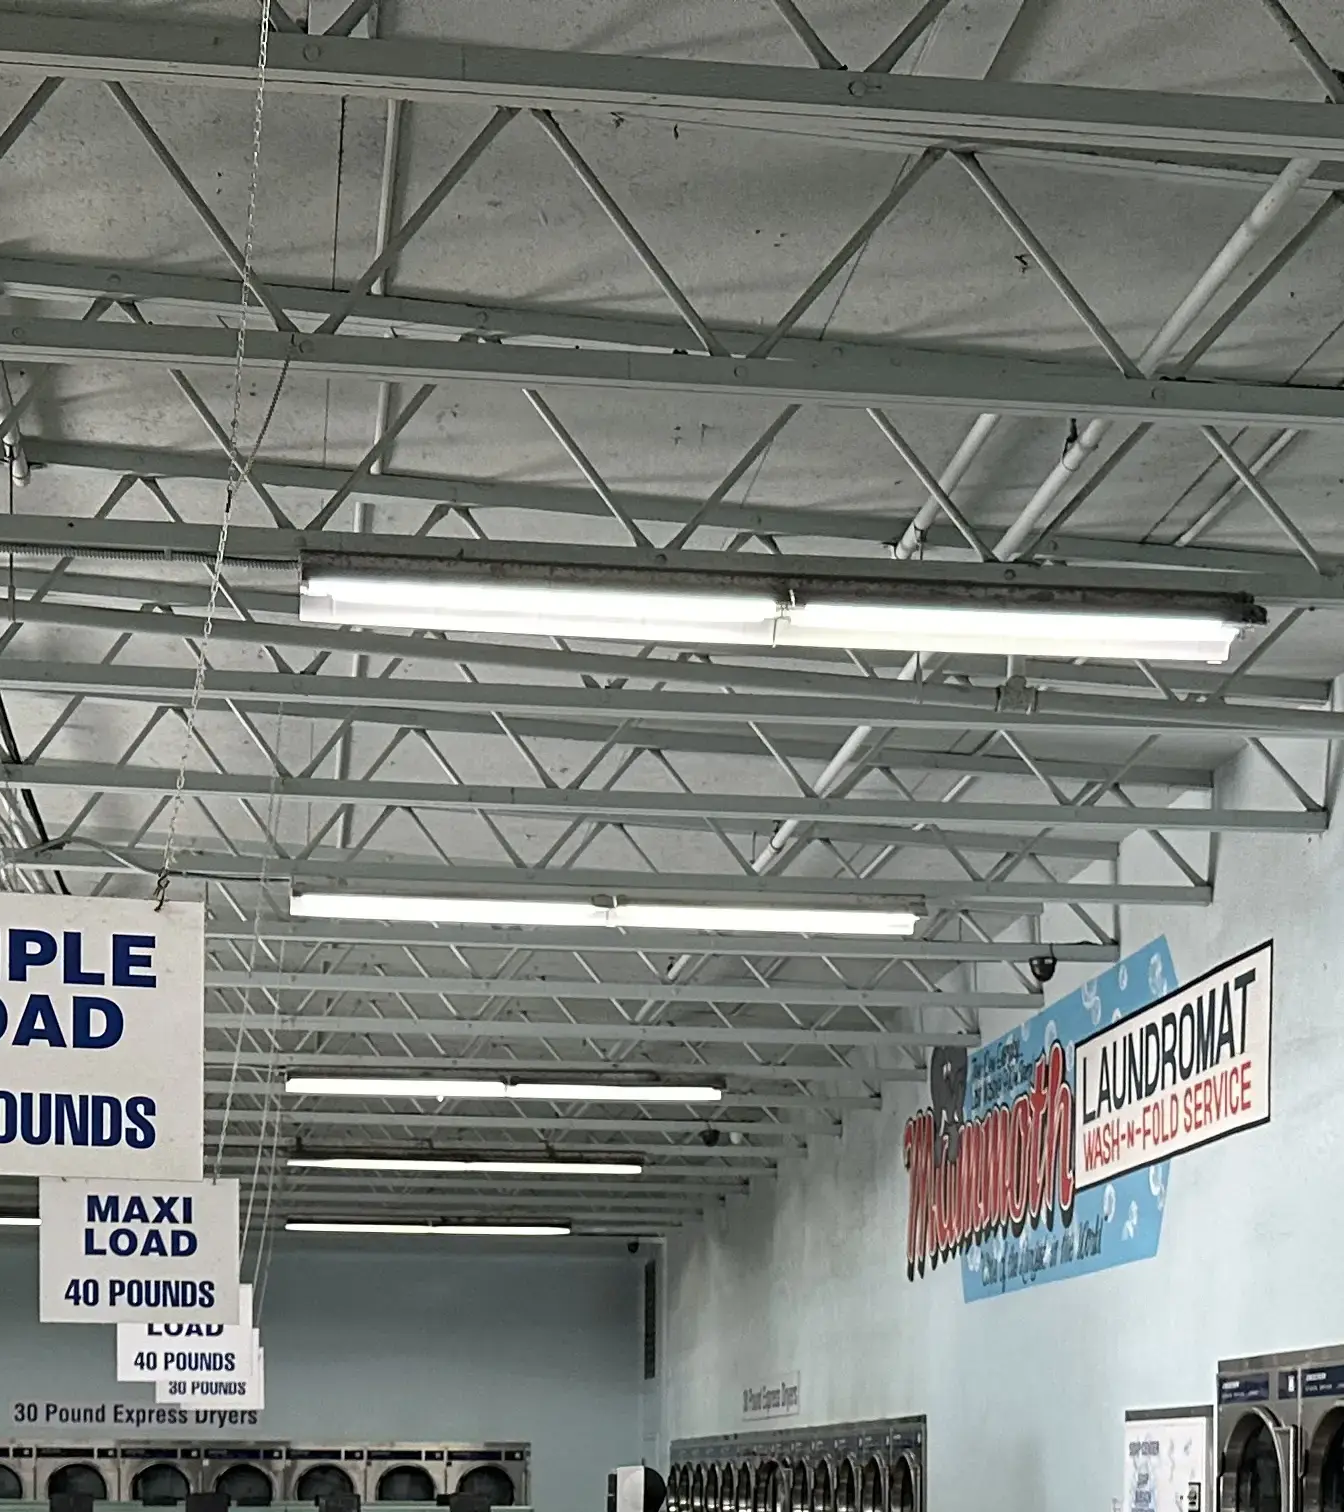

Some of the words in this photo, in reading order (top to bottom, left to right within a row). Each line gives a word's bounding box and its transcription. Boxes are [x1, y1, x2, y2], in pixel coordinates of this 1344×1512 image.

[1082, 967, 1257, 1126] LAUNDROMAT
[1083, 1092, 1180, 1173] WASH-N-FOLD
[1183, 1060, 1253, 1133] SERVICE
[86, 1195, 194, 1225] MAXI
[83, 1227, 199, 1258] LOAD
[64, 1278, 100, 1307] 40
[108, 1279, 216, 1309] POUNDS
[147, 1323, 225, 1337] LOAD
[134, 1351, 158, 1372] 40
[163, 1351, 236, 1372] POUNDS
[190, 1380, 247, 1396] POUNDS
[14, 1402, 38, 1423] 30
[45, 1403, 106, 1424] Pound
[113, 1404, 189, 1428] Express
[195, 1408, 259, 1428] Dryers
